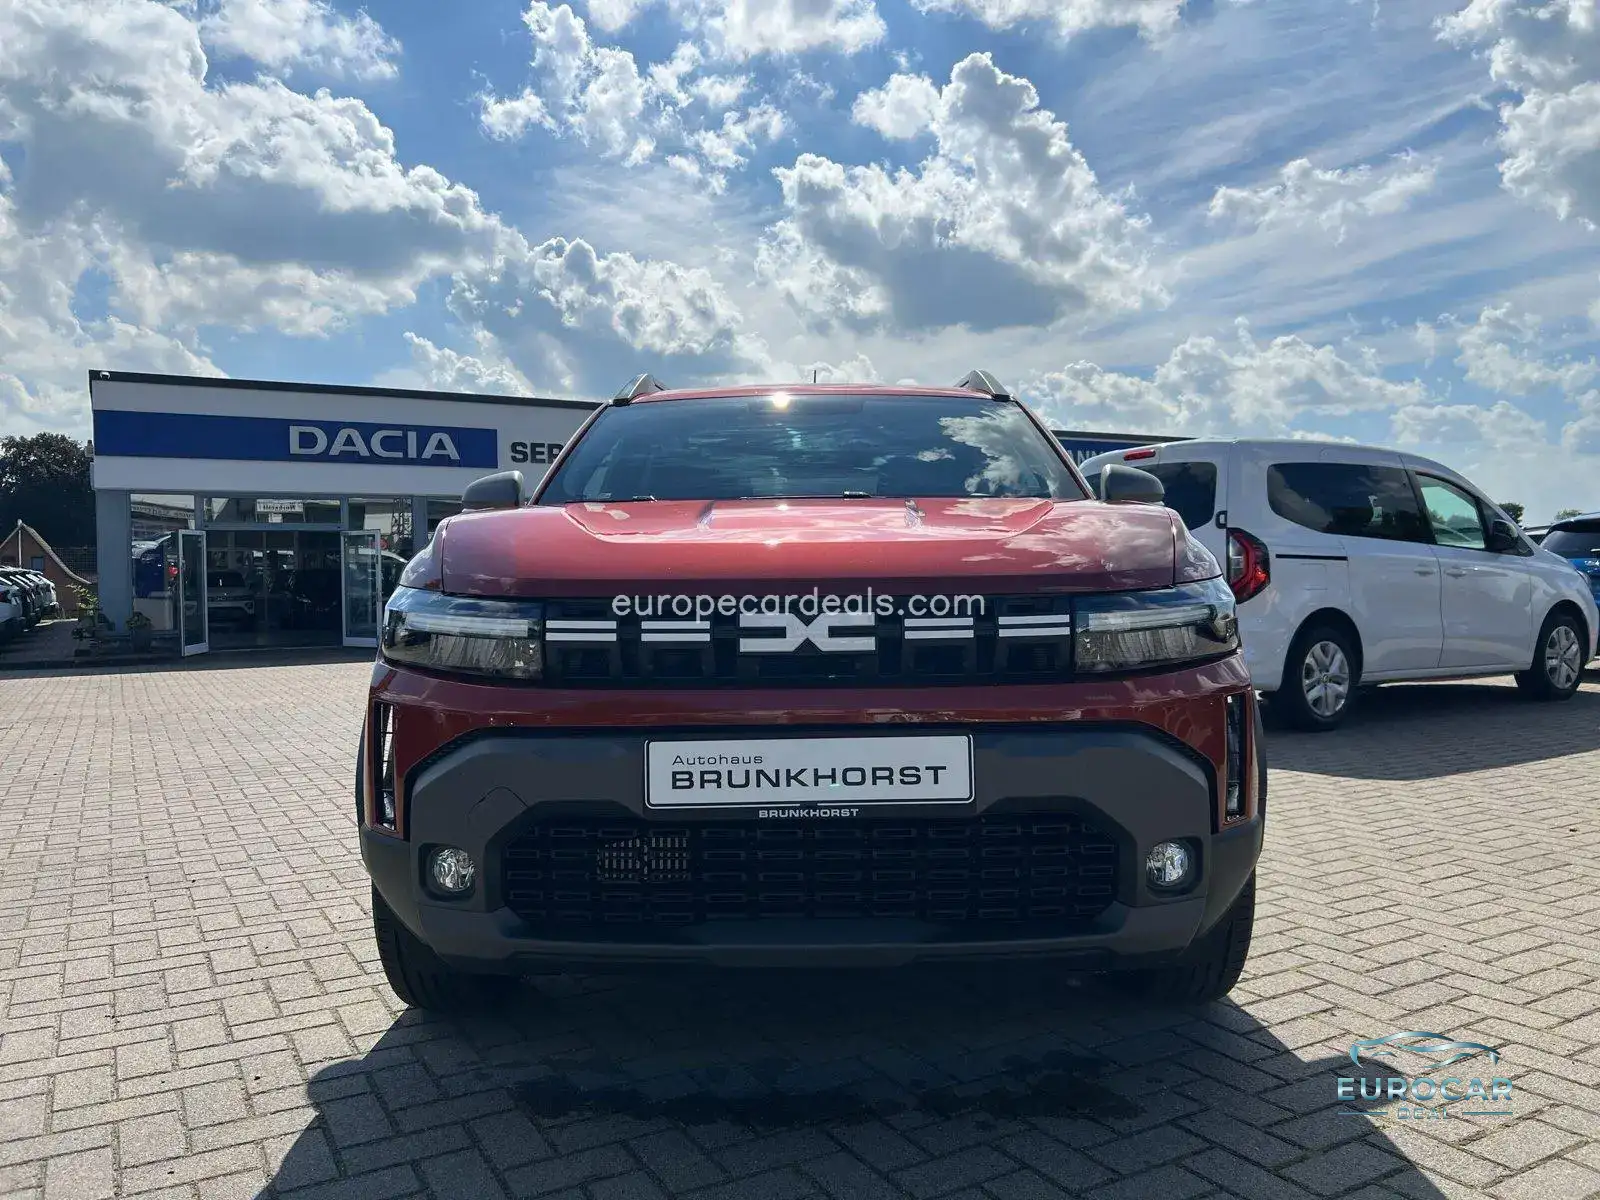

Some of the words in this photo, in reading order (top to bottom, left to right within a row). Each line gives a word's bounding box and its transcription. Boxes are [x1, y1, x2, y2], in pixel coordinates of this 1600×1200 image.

[289, 425, 461, 460] DACIA
[672, 754, 763, 766] Autohaus
[671, 765, 947, 790] BRUNKHORST
[758, 808, 860, 819] BRUNKHORST
